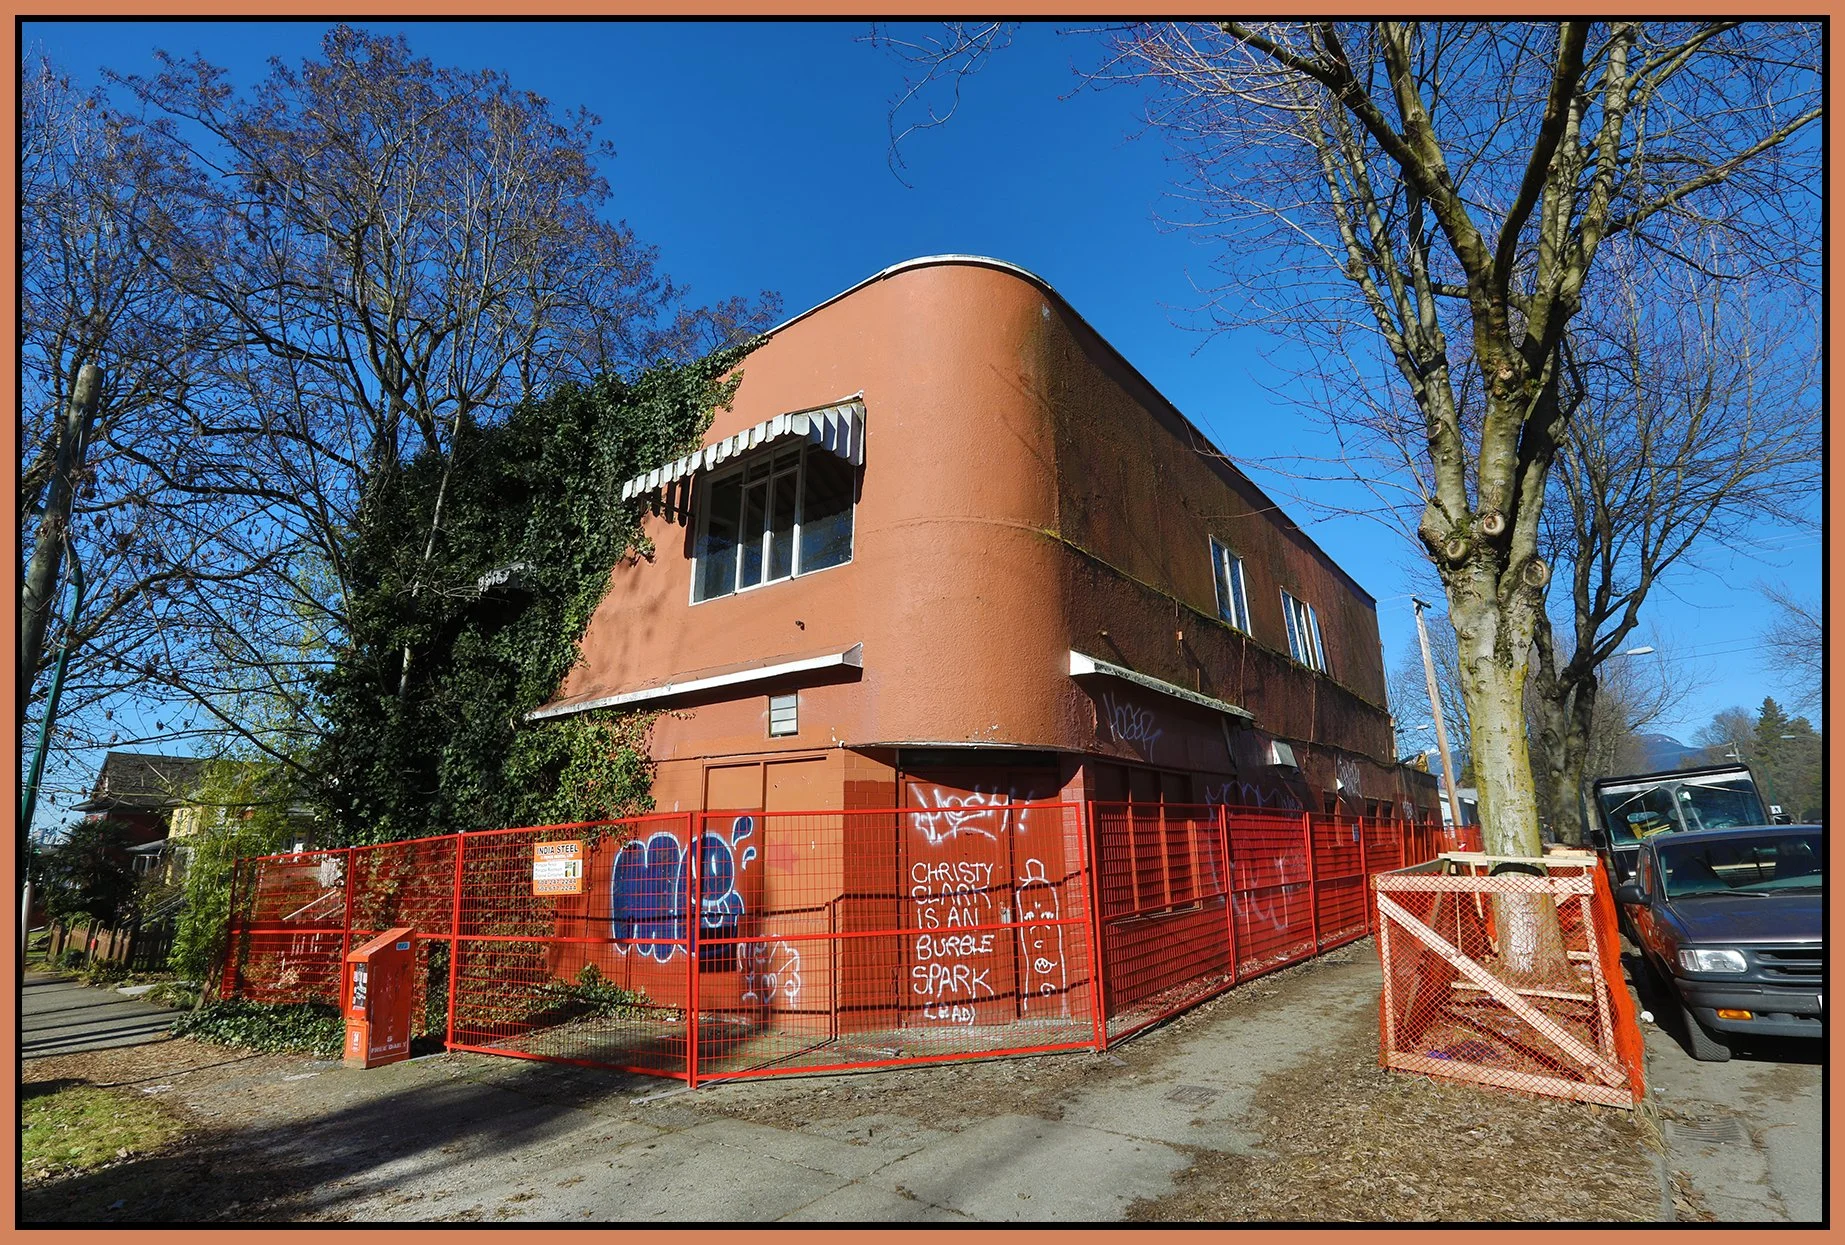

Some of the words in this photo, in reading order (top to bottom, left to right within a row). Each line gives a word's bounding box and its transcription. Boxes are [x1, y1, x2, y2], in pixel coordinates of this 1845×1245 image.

[537, 846, 554, 854] INDIA
[557, 845, 578, 853] STEEL
[912, 862, 993, 884] CHRISTY
[912, 882, 991, 909] CLARK
[917, 907, 940, 929] IS
[948, 907, 978, 927] AN
[916, 934, 994, 960] BURBLE
[912, 963, 994, 999] SPARK
